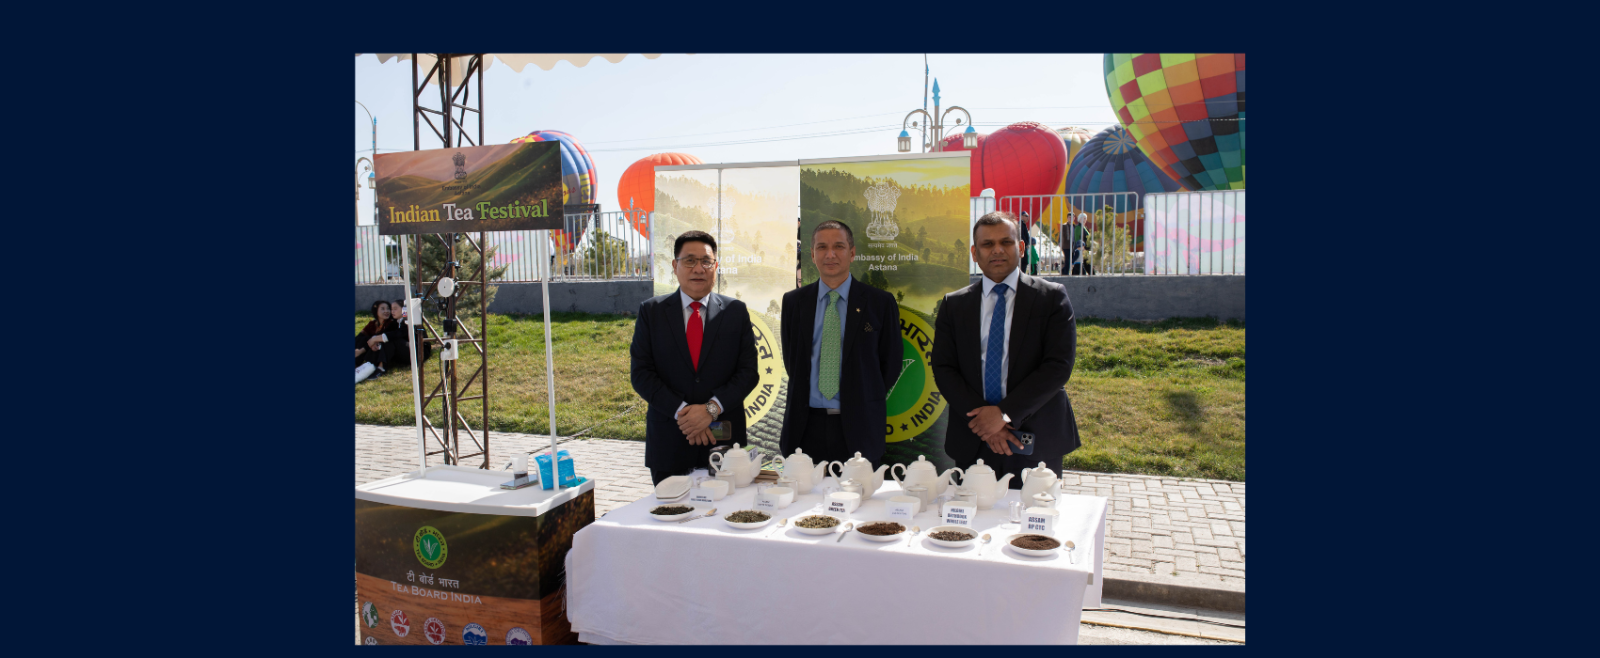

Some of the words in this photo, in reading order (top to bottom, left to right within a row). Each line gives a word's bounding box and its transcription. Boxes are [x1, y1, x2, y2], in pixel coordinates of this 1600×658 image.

[389, 205, 441, 224] Indian
[443, 203, 474, 221] Tea
[476, 199, 550, 220] Festival
[726, 254, 736, 263] of
[738, 254, 762, 263] India
[854, 253, 886, 263] mbassy
[887, 253, 897, 261] of
[898, 253, 919, 261] India
[717, 266, 738, 275] tana
[868, 263, 898, 271] Astana
[745, 383, 774, 419] INDIA
[910, 391, 941, 427] INDIA
[406, 570, 415, 582] टी
[419, 572, 434, 586] बोर्ड
[439, 577, 460, 589] भारत
